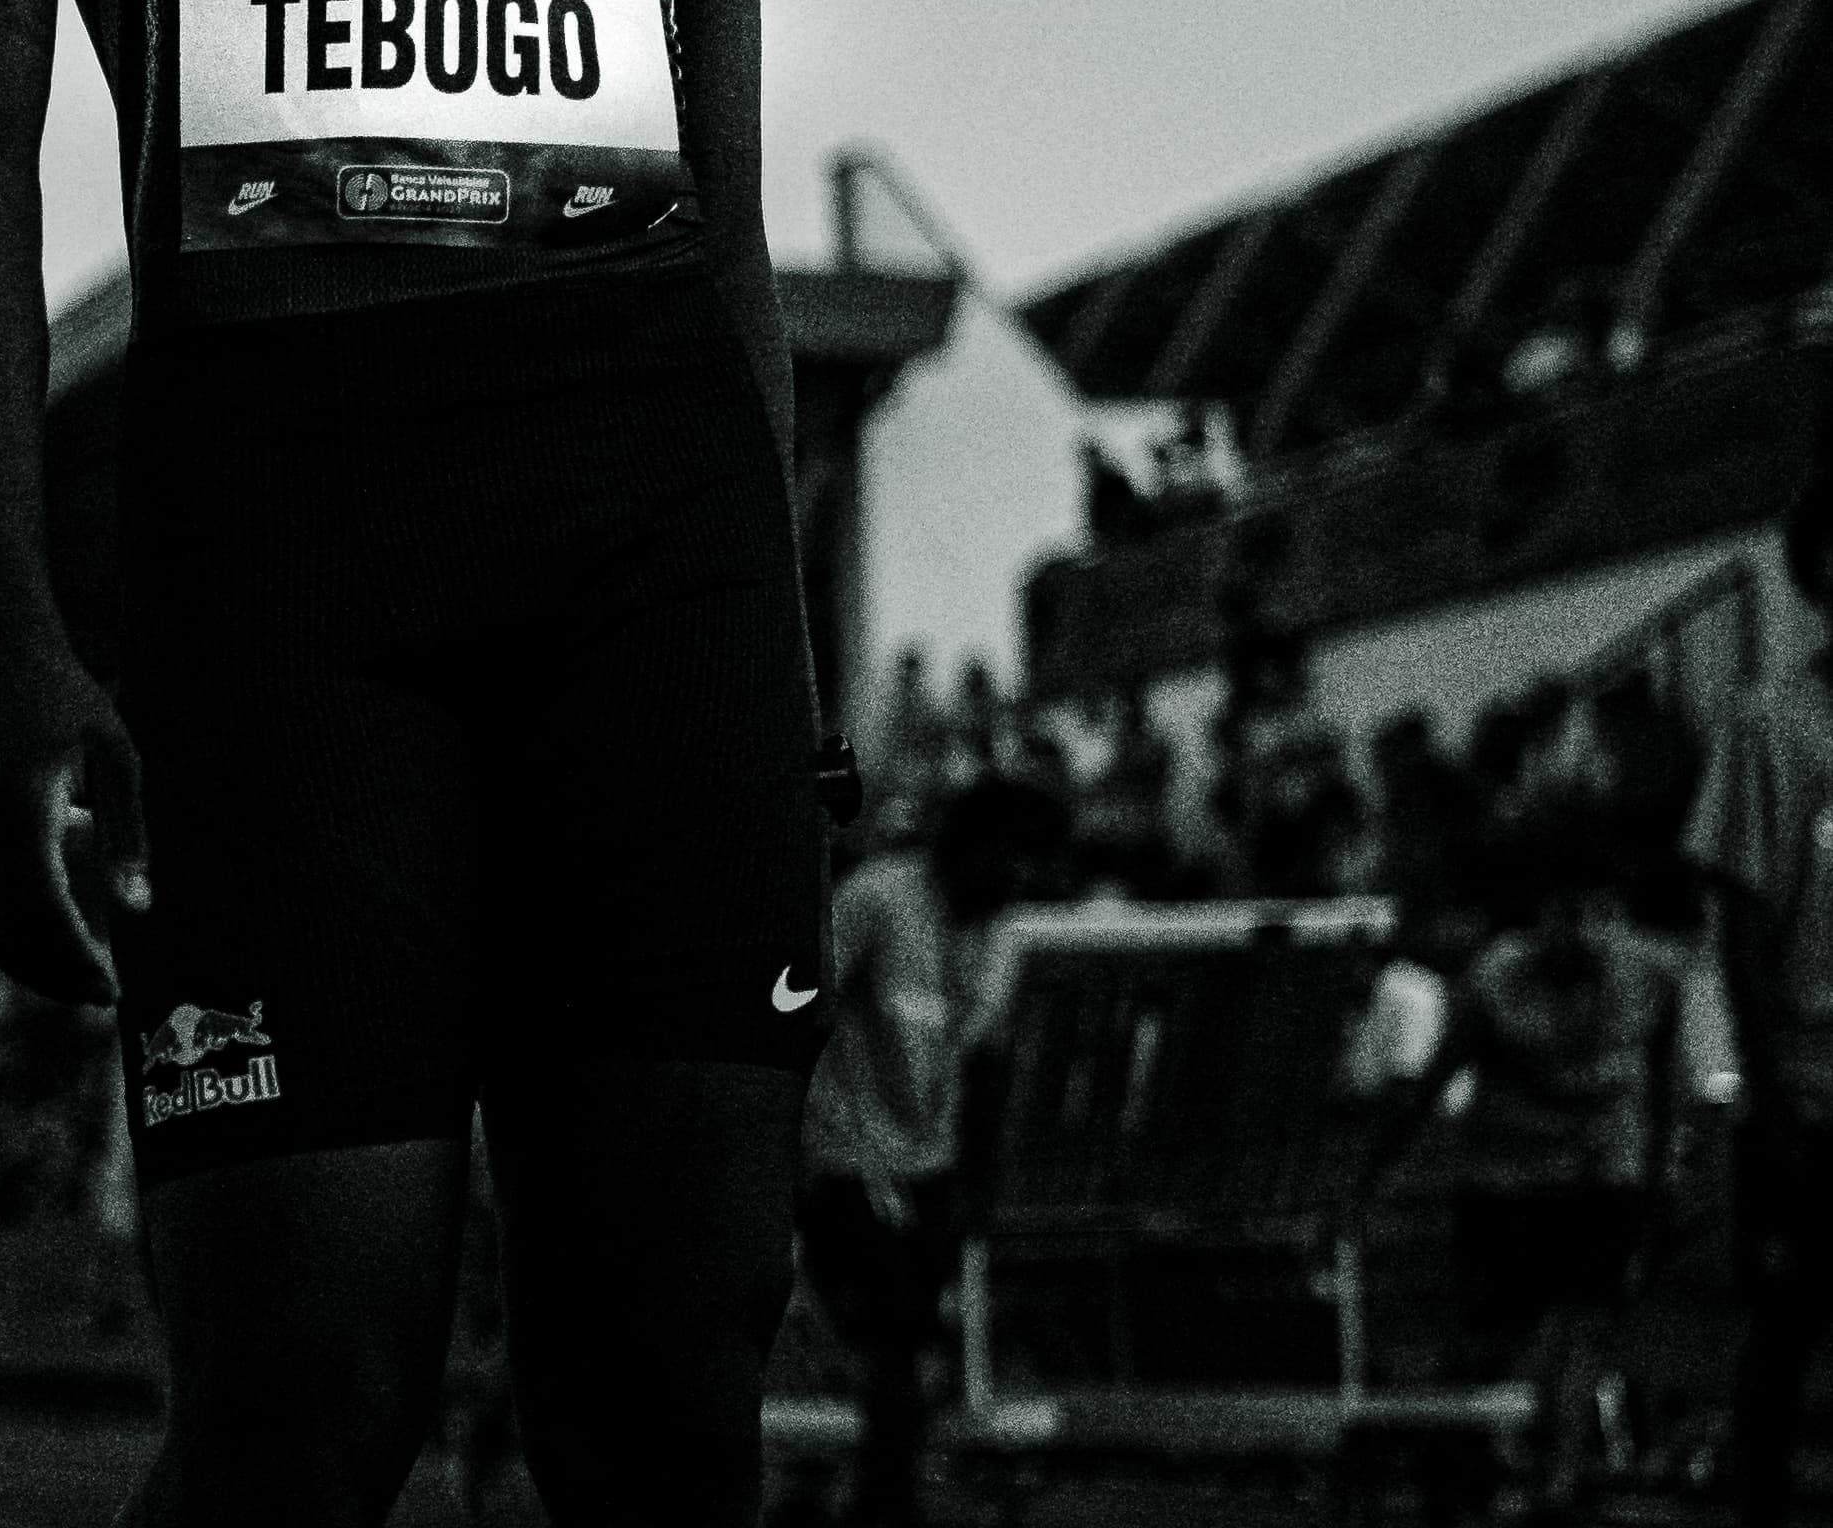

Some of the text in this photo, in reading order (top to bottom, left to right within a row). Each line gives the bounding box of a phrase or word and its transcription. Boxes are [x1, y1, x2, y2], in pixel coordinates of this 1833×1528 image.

[238, 181, 275, 200] RUN
[574, 185, 614, 204] RUN
[194, 1054, 281, 1111] Bull
